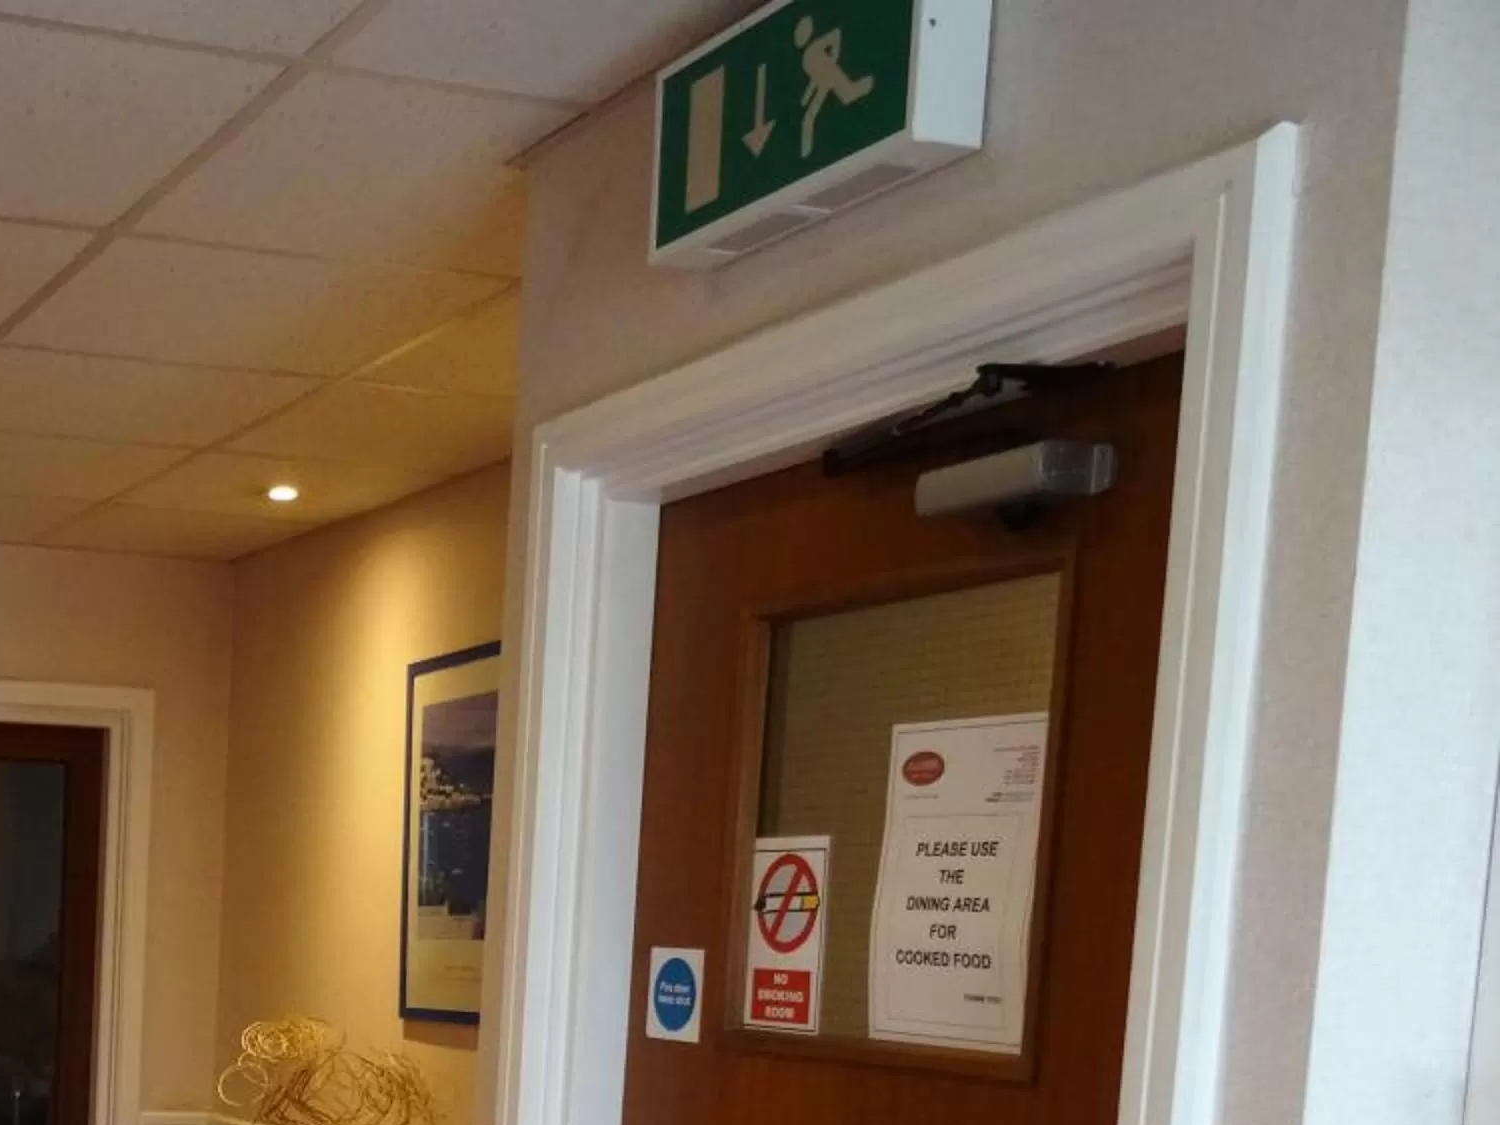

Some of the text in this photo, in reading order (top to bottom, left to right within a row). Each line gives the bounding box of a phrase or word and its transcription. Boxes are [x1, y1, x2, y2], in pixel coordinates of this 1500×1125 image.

[915, 840, 999, 858] PLEASE USE
[939, 868, 965, 885] THE
[905, 895, 991, 913] DINING AREA
[929, 923, 958, 940] FOR
[895, 948, 993, 969] COOKED FOOD
[773, 970, 789, 986] NO
[757, 987, 805, 1003] SMOKING
